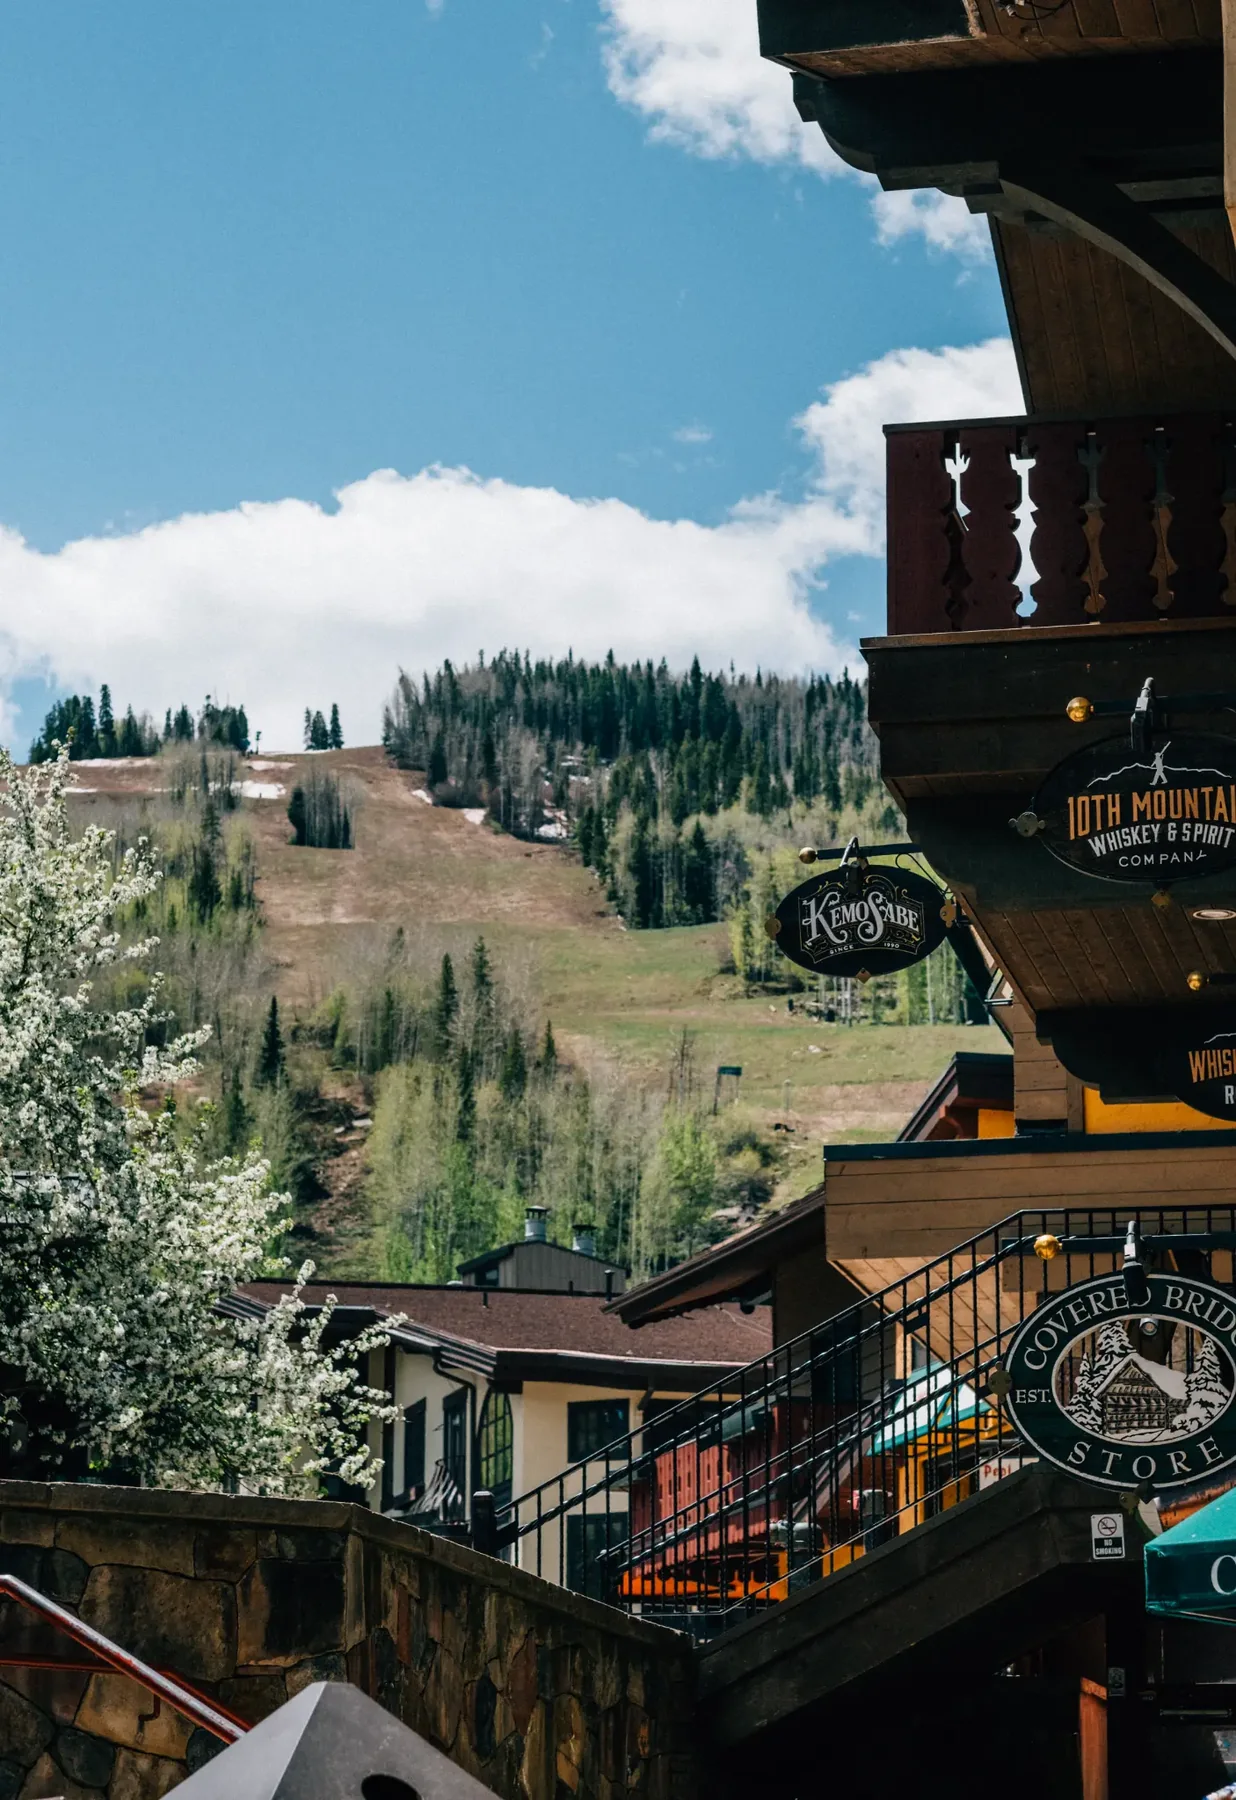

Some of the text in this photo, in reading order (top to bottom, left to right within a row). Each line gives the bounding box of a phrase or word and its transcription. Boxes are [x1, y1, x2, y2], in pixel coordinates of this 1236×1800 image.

[1067, 793, 1121, 841] 10TH
[1088, 822, 1235, 857] WHISKEY & SPIRIT
[1118, 849, 1207, 868] COMPANY
[829, 944, 854, 955] SINCE
[1188, 1048, 1236, 1083] WHIS
[1162, 1284, 1236, 1347] BRID
[1015, 1389, 1052, 1404] EST.
[1066, 1435, 1224, 1480] STORE
[1095, 1546, 1122, 1555] SMOKING
[1104, 1538, 1113, 1546] NO
